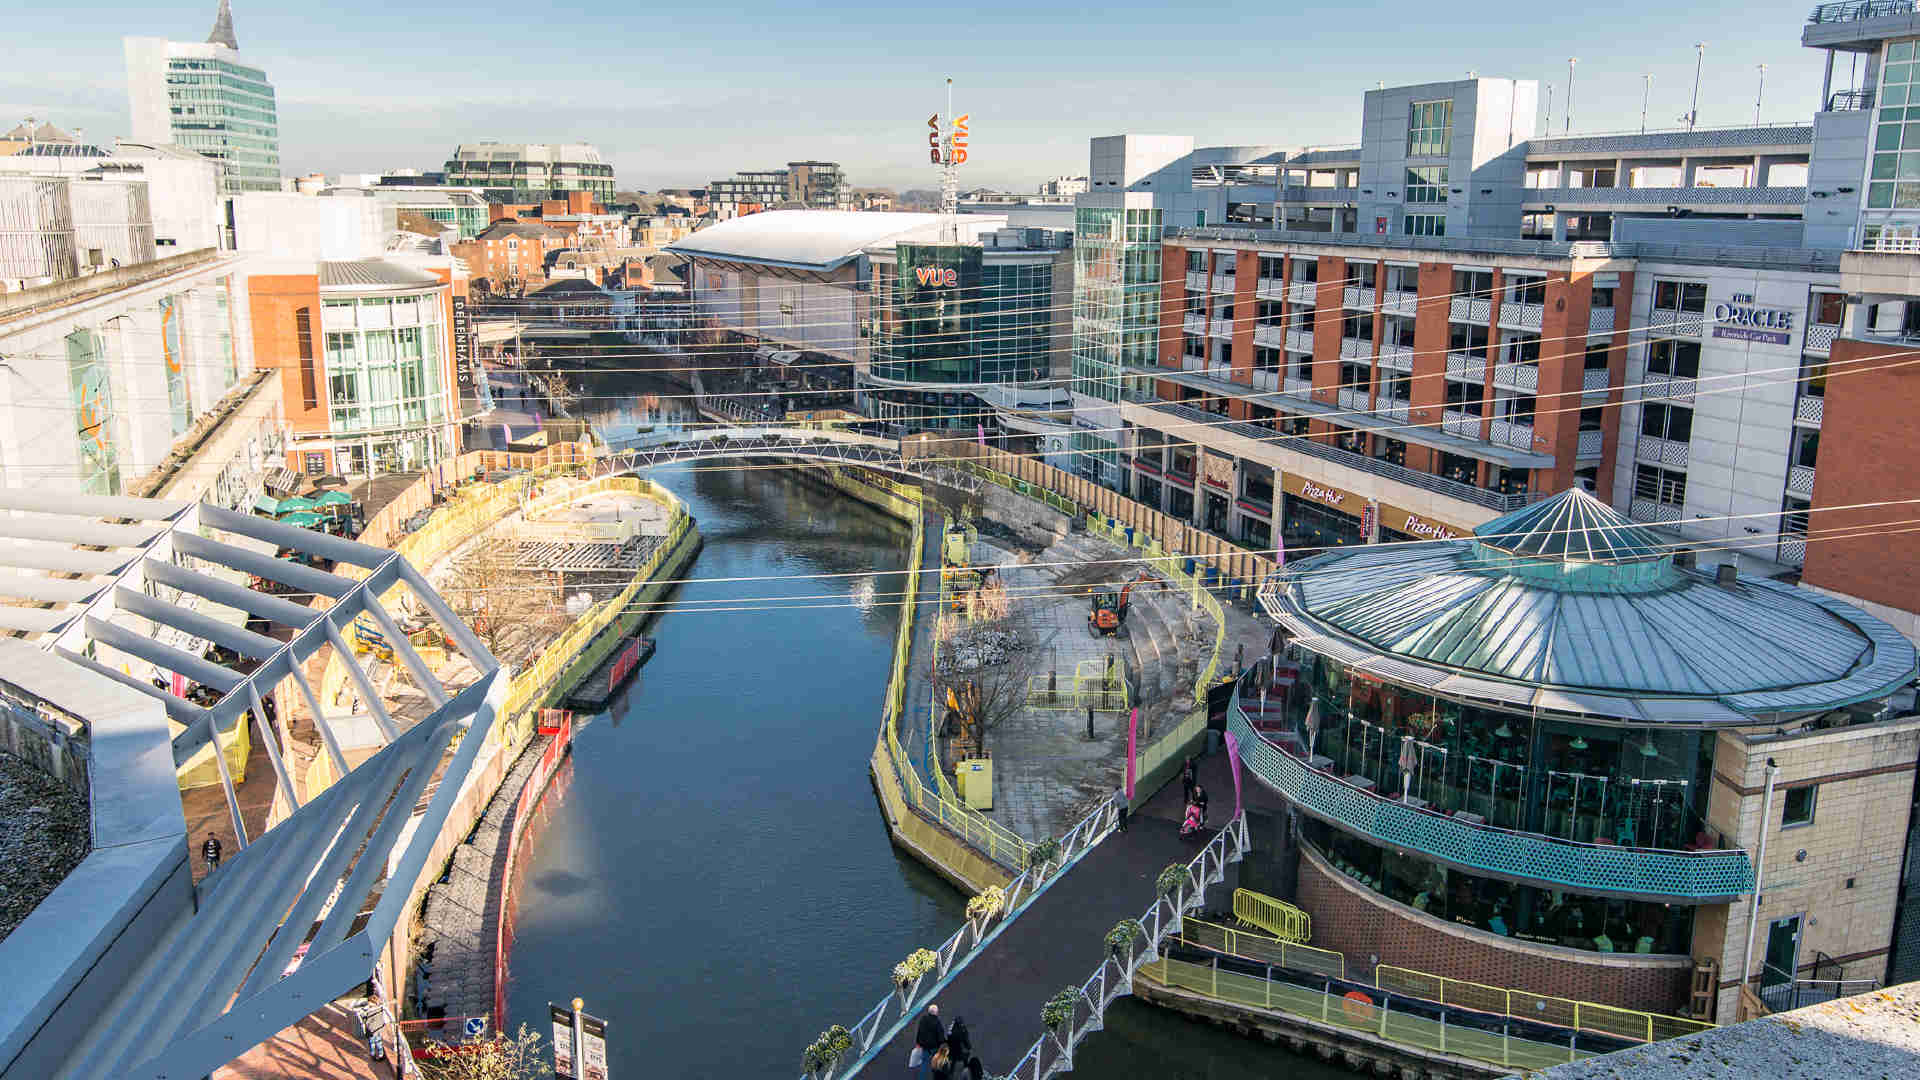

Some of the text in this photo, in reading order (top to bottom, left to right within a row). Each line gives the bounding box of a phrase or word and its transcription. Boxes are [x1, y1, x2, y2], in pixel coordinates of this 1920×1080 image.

[1714, 304, 1793, 329] ORACLE
[455, 301, 469, 382] DEBENHAMS
[1303, 480, 1345, 504] Pizza Hut
[1405, 515, 1459, 541] Pizza Hut
